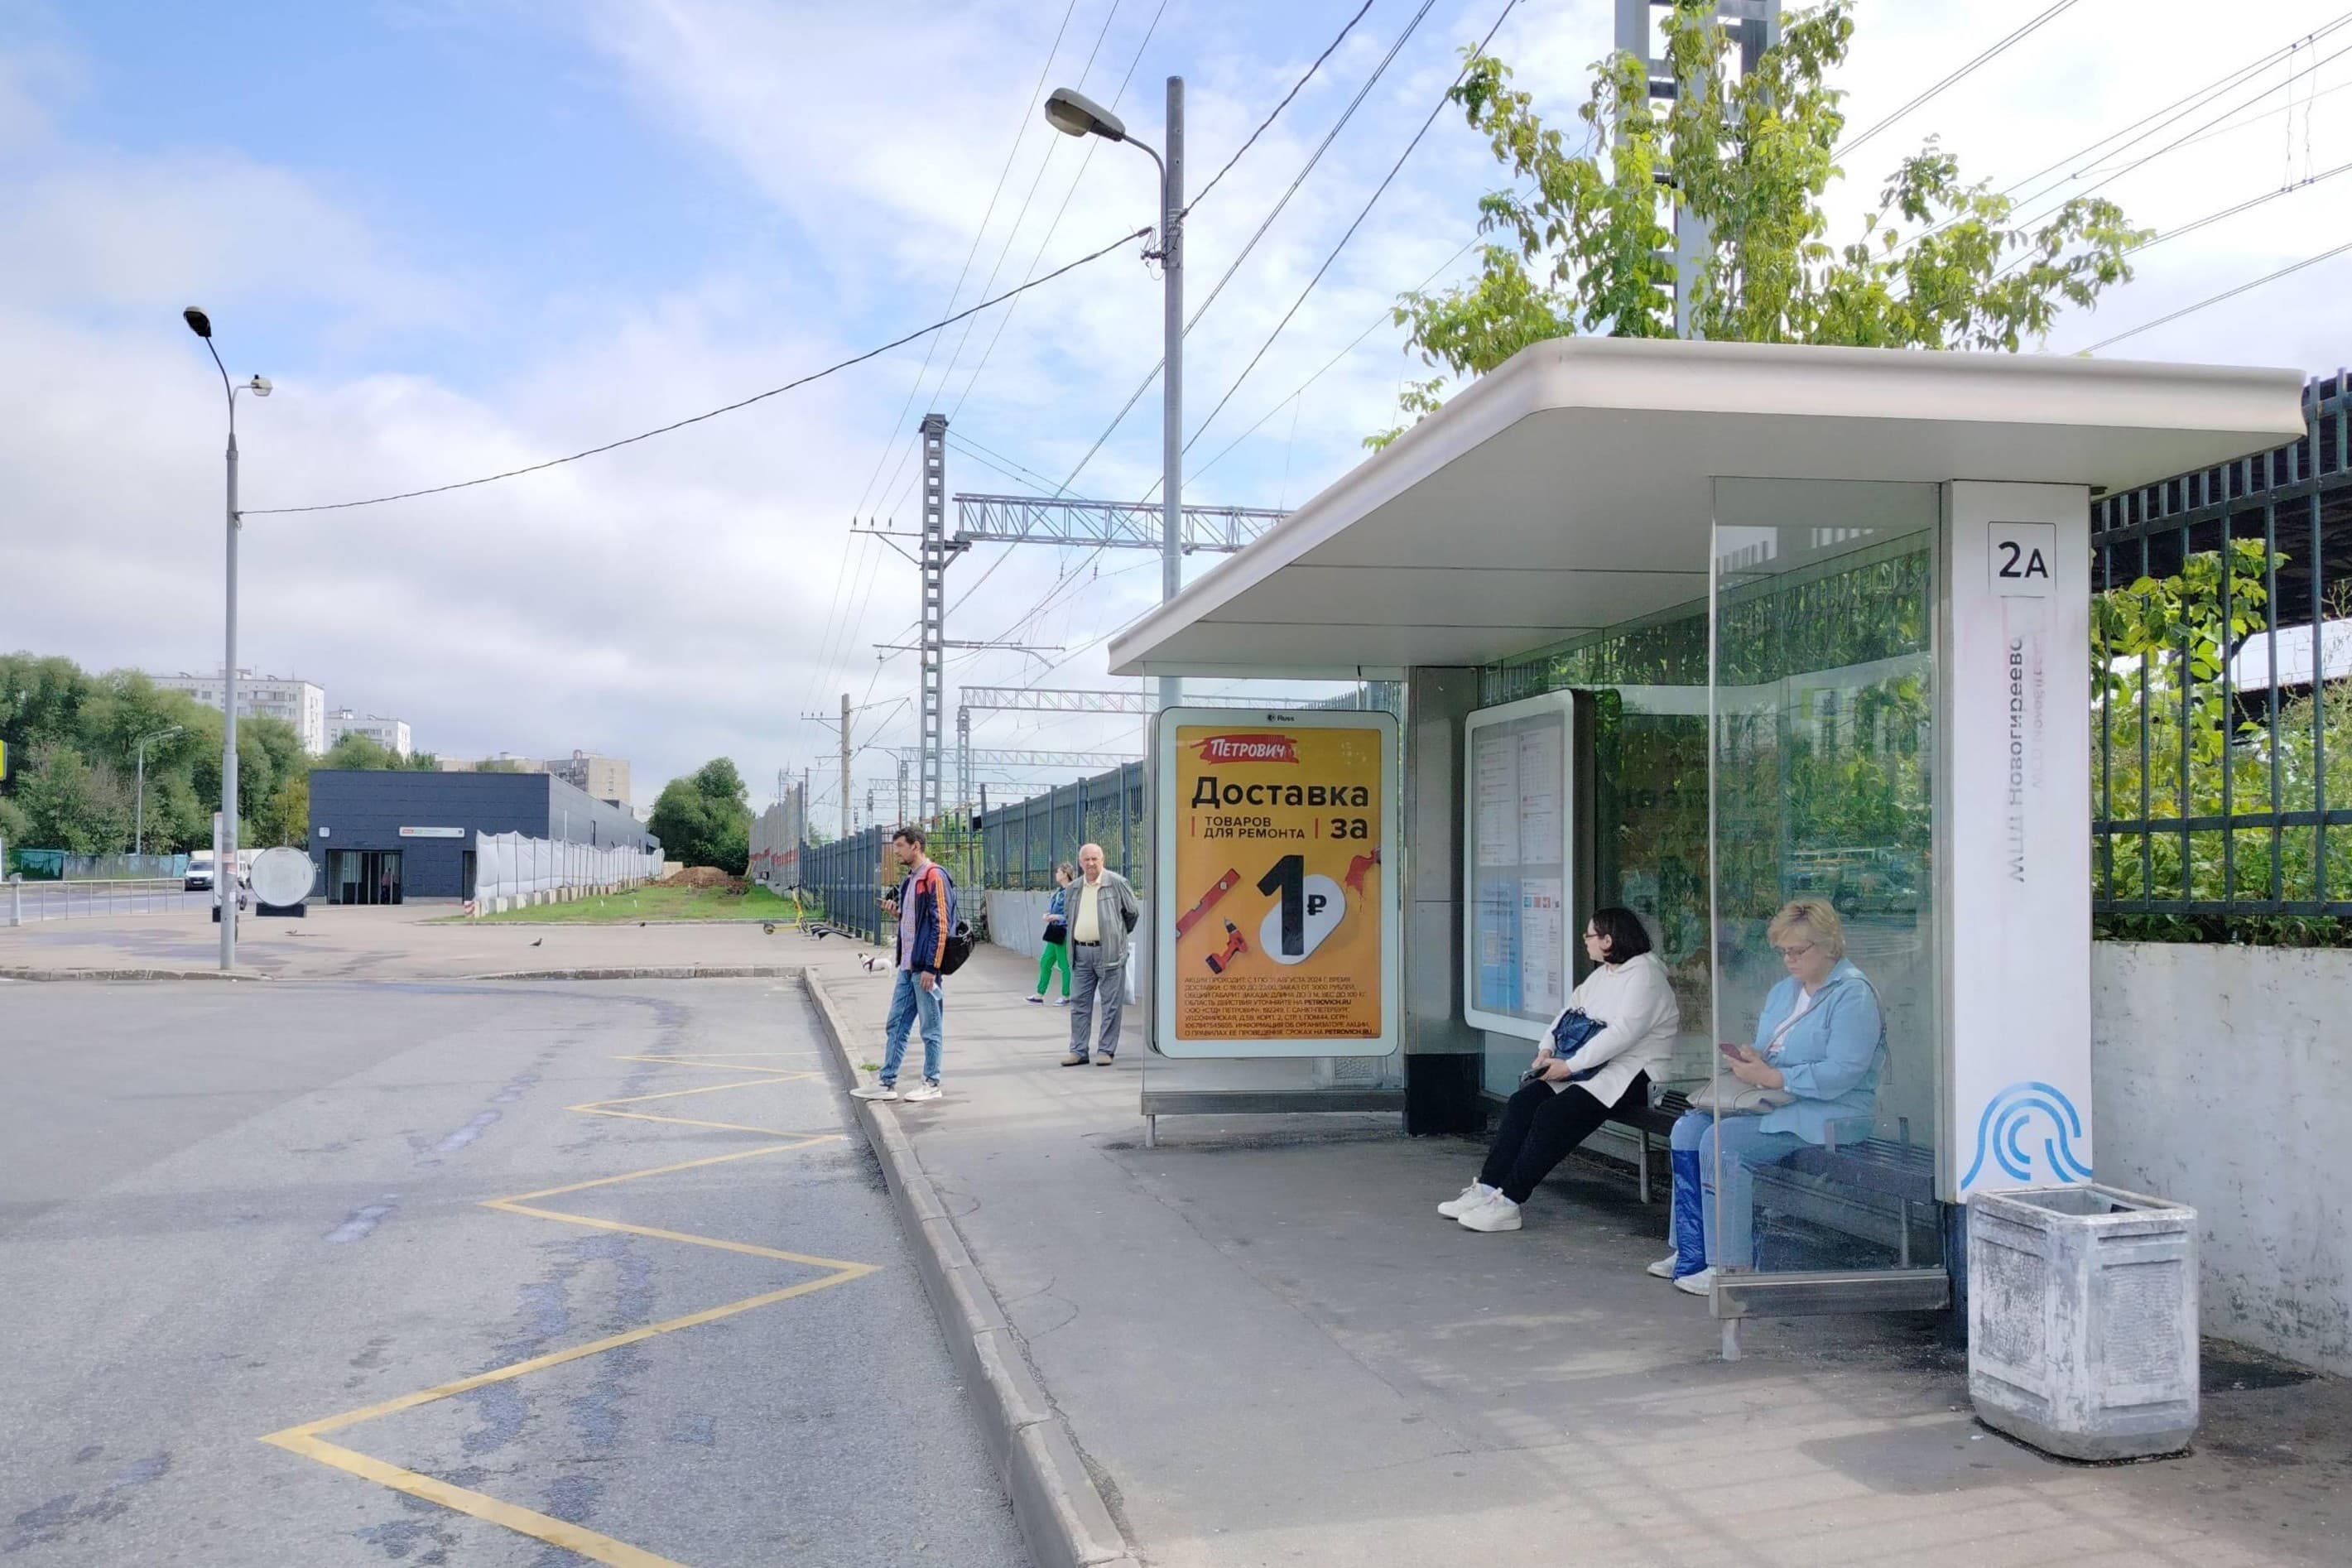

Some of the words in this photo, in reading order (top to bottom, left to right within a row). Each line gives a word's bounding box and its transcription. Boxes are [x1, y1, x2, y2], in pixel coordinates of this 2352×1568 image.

[1998, 541, 2049, 579] 2А
[1210, 738, 1286, 758] ПЕТРОВИЧ
[1191, 777, 1369, 809] Доставка
[1205, 815, 1272, 827] ТОВАРОВ
[1330, 817, 1368, 839] за
[1204, 827, 1234, 839] ДЛЯ
[1239, 828, 1306, 839] РЕМОНТА
[1256, 854, 1305, 956] 1
